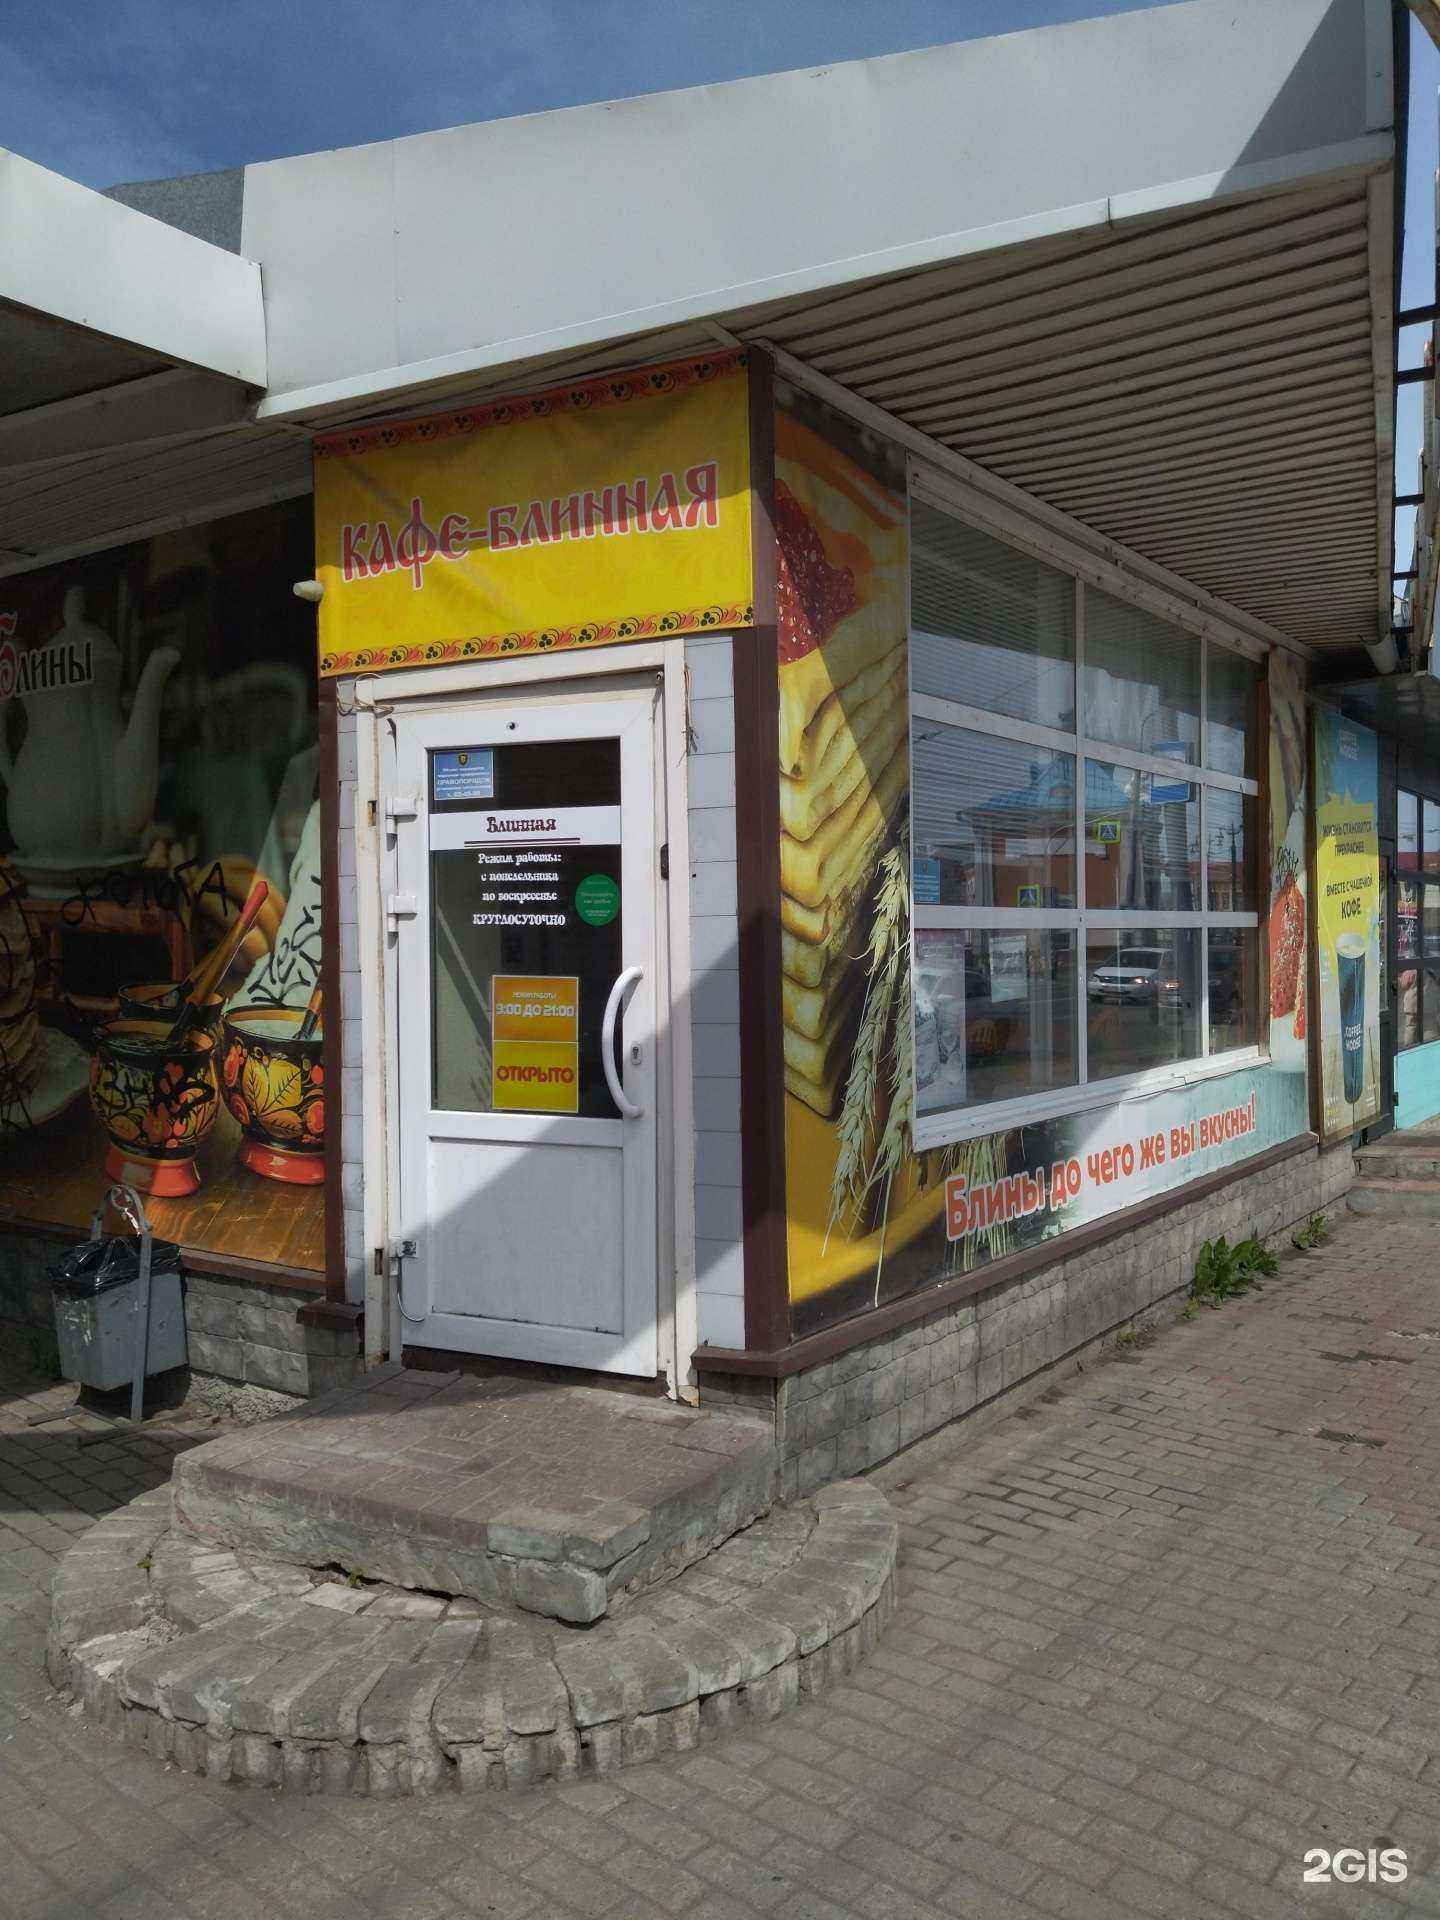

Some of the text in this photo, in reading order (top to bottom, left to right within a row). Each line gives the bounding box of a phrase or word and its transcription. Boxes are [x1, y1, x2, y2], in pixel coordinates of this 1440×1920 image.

[341, 460, 720, 590] КАФЕ-БЛИННАЯ
[486, 816, 557, 833] Блинная
[478, 852, 562, 866] Режим работы:
[480, 872, 560, 882] с понедельника
[482, 892, 558, 904] по воскресенье
[1340, 897, 1361, 920] КОФЕ
[472, 913, 567, 926] КРУГЛОСУТОЧНО
[496, 1065, 575, 1084] ОТКРЫТО
[945, 1091, 1257, 1241] Блины до чего же вы вкусны!
